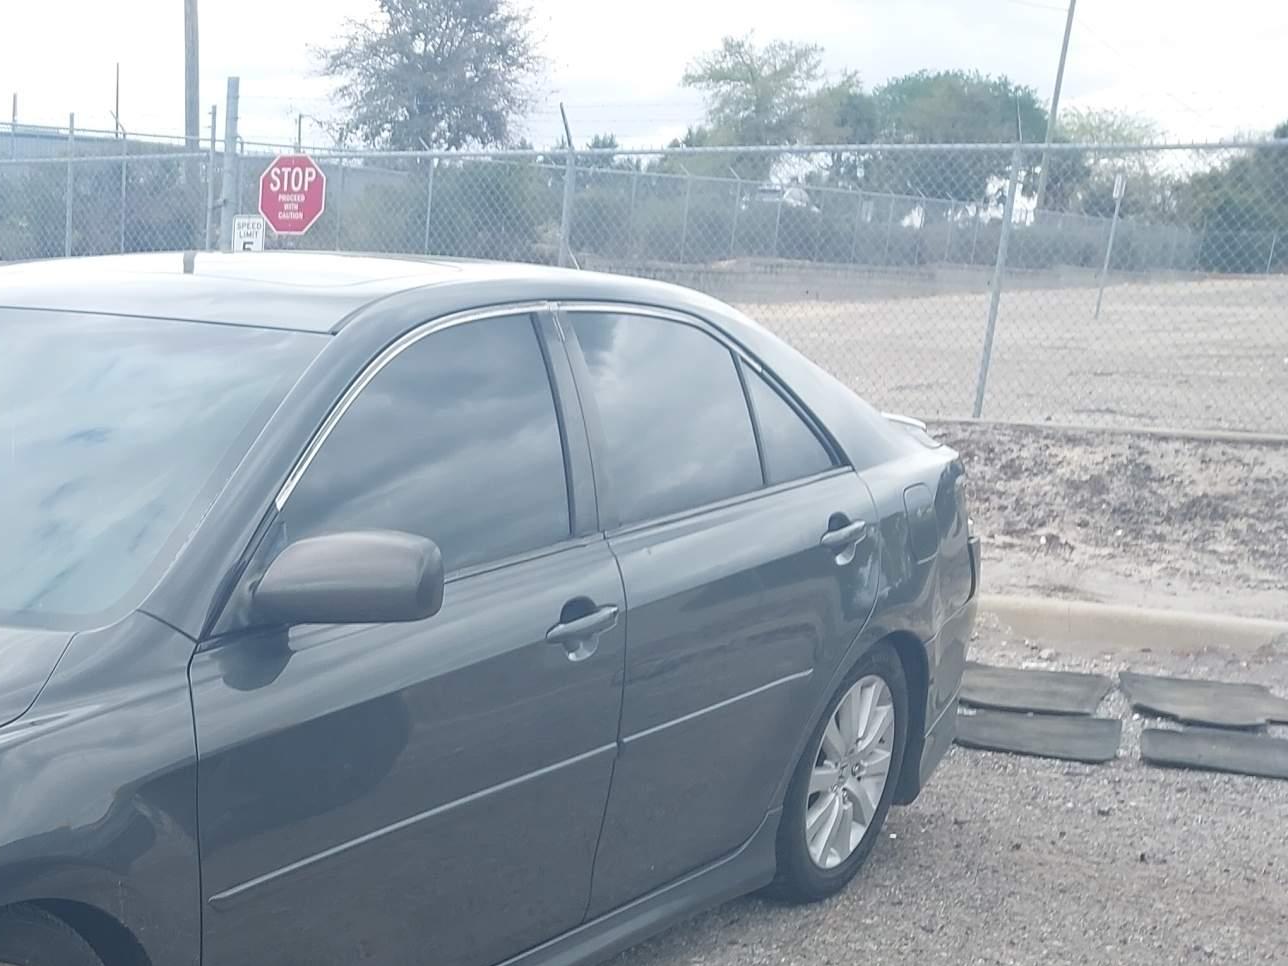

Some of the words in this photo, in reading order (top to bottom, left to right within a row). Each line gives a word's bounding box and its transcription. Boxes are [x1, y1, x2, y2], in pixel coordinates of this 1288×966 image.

[270, 167, 316, 192] STOP
[278, 194, 305, 202] PROCEED
[284, 203, 298, 211] WITH
[278, 211, 303, 220] CAUTION
[237, 222, 262, 230] SPEED
[239, 231, 258, 239] LIMIT
